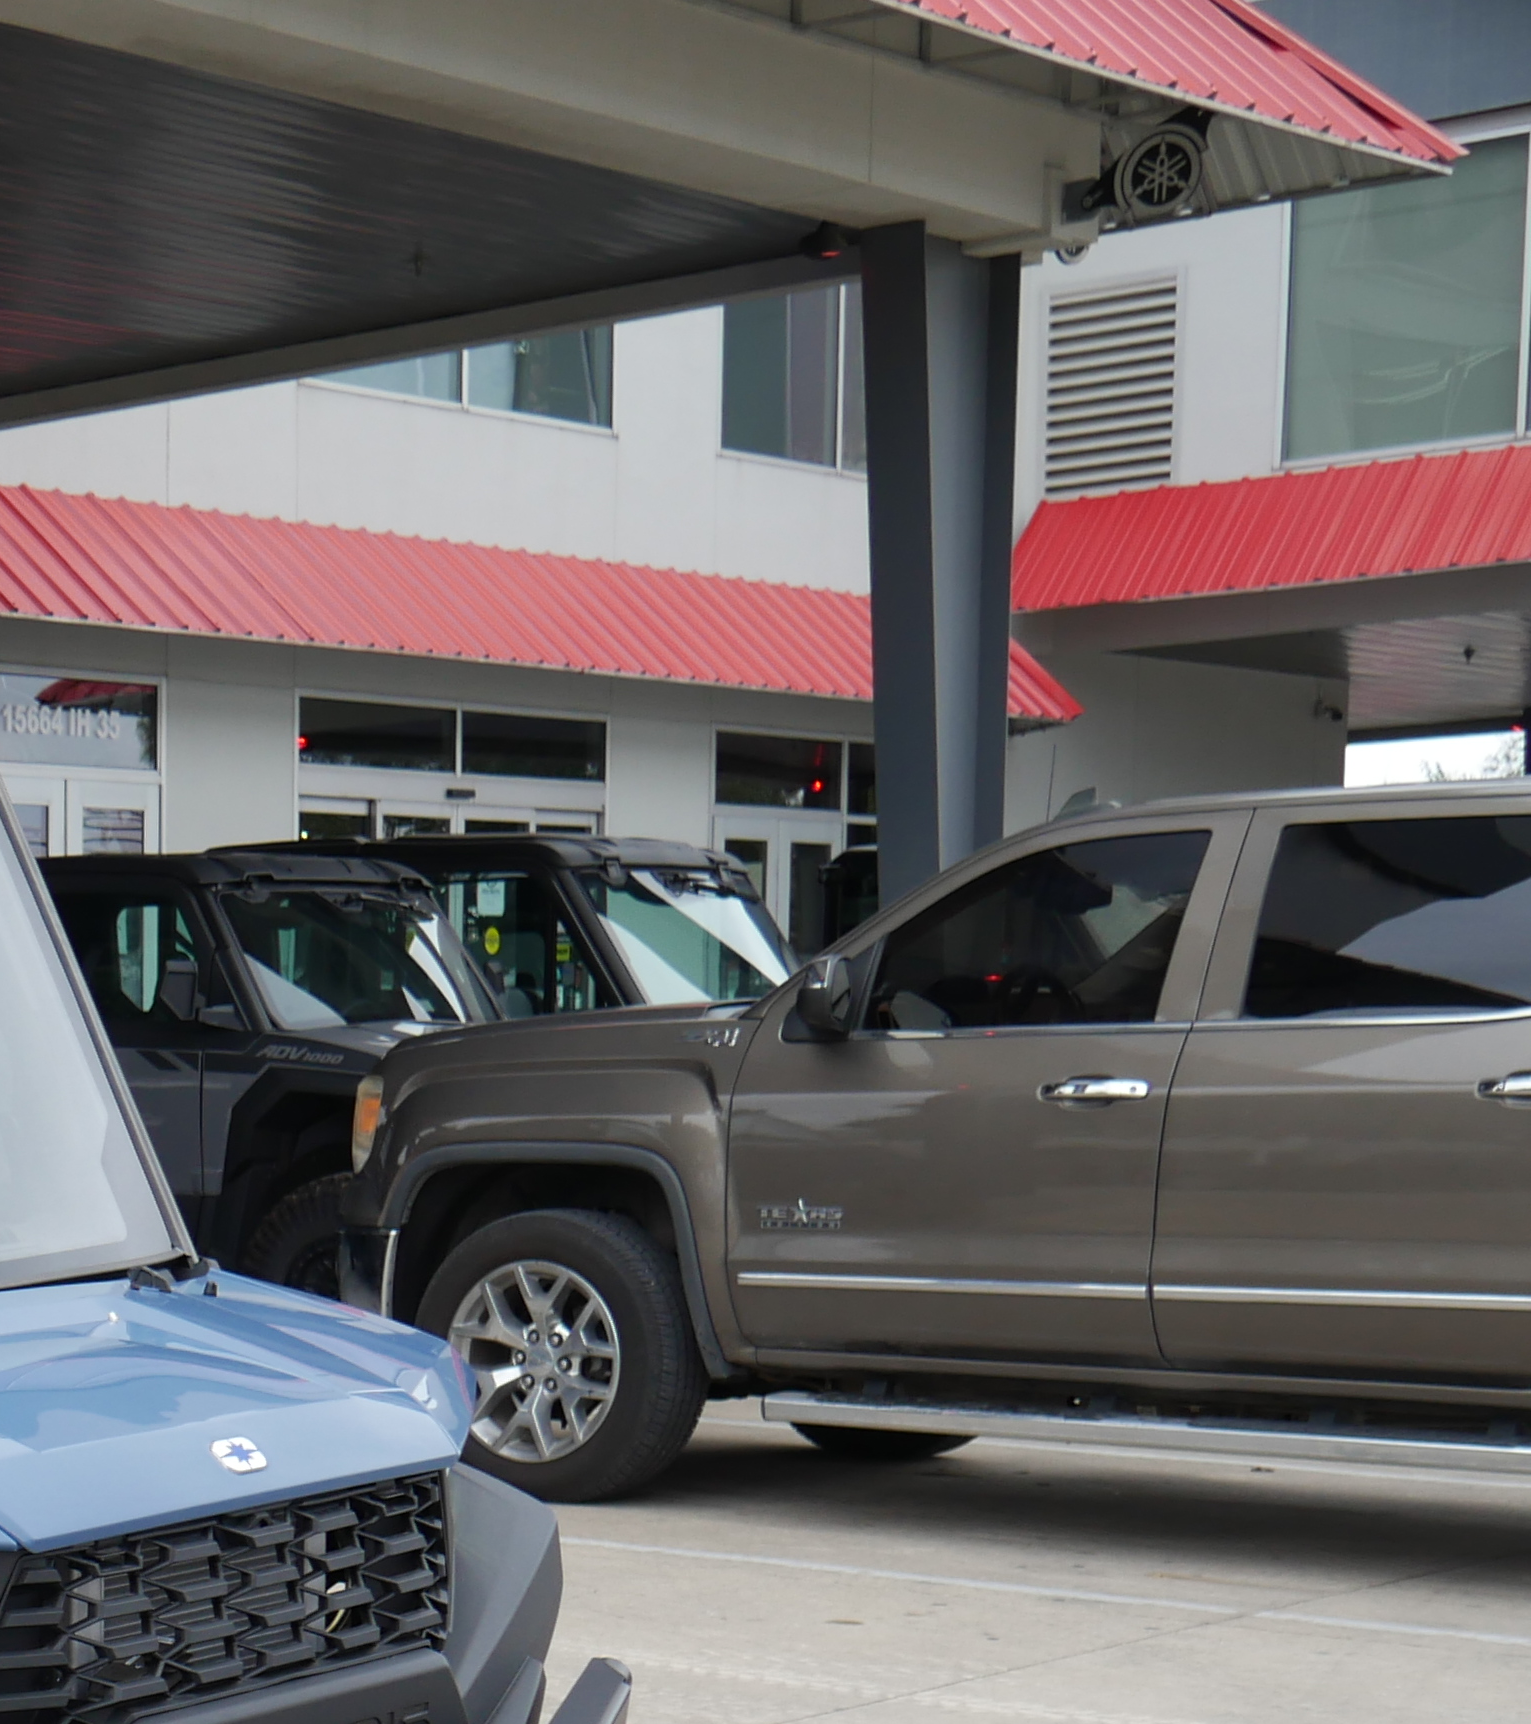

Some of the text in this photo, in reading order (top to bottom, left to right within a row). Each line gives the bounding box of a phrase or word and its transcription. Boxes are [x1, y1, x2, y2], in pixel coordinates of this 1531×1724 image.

[1, 704, 121, 740] 15664 IH 35
